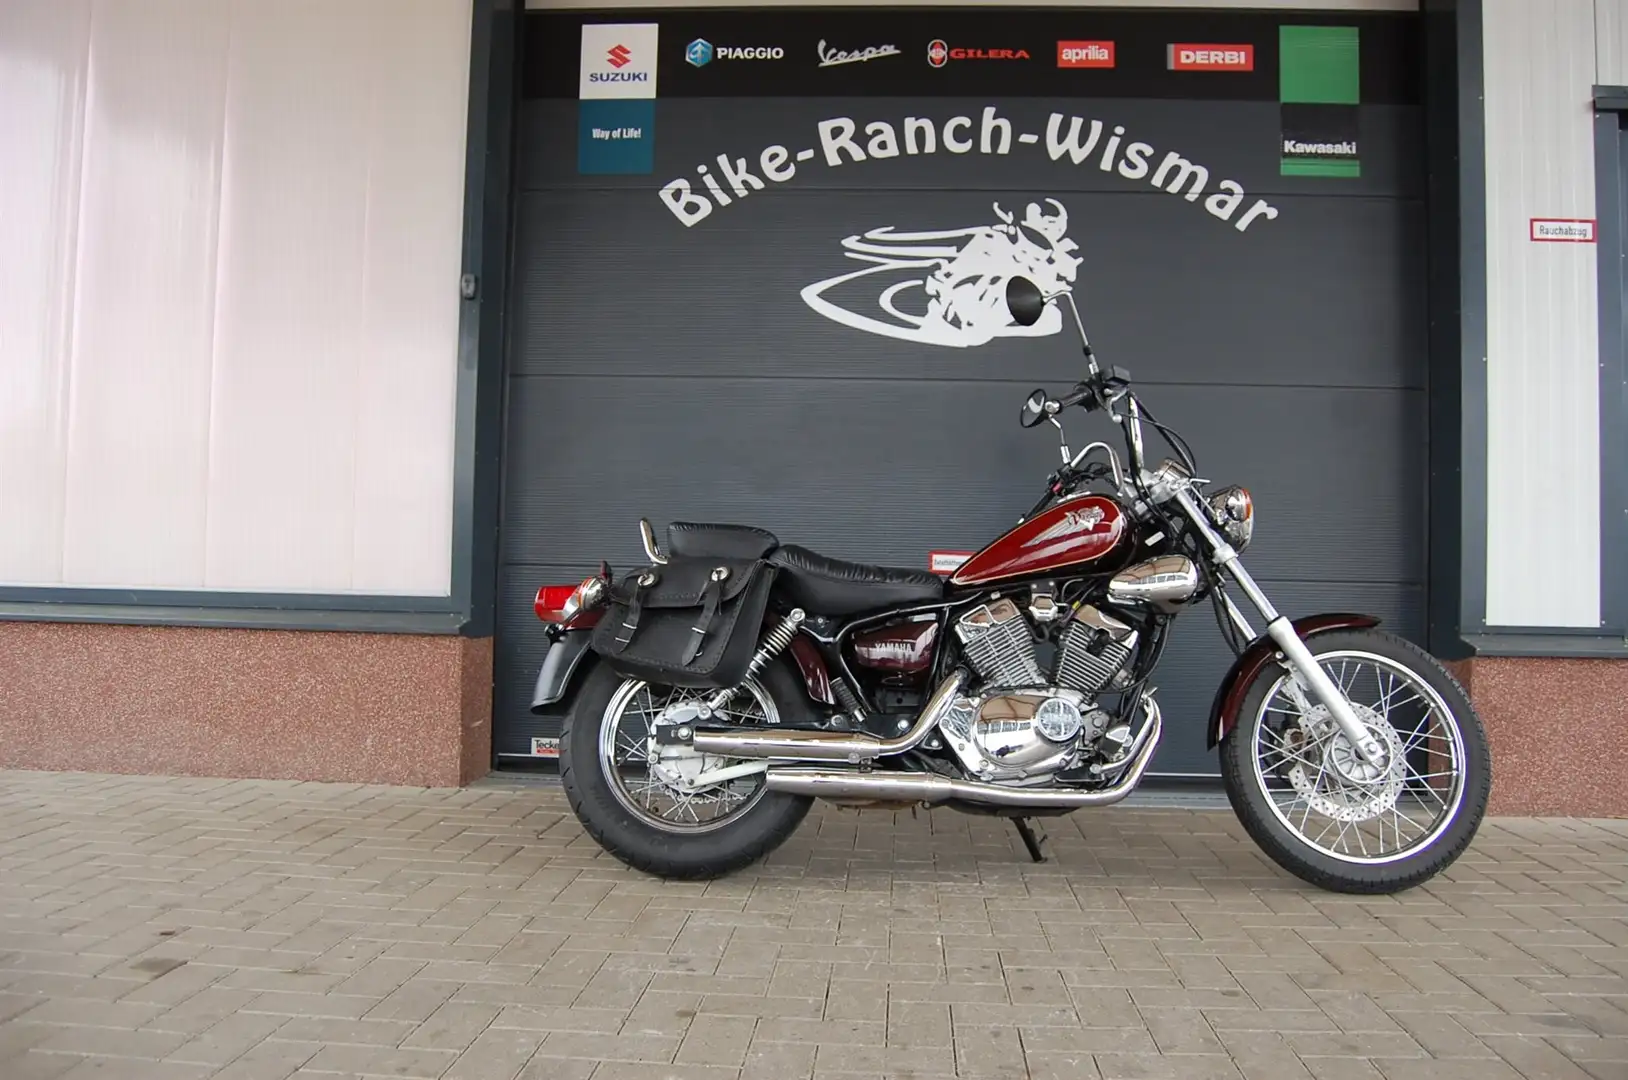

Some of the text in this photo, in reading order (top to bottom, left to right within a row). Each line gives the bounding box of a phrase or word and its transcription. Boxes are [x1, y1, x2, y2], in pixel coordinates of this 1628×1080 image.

[716, 47, 784, 60] PIAGGIO
[817, 39, 901, 68] Vespa
[949, 48, 1030, 60] GILERA
[1061, 45, 1109, 62] aprilia
[1179, 50, 1246, 65] DERBI
[589, 72, 648, 82] SUZUKI
[592, 127, 641, 140] Way of Life!
[1284, 139, 1357, 155] Kawasaki
[658, 106, 1278, 231] Bike-Ranch-Wismar
[1539, 225, 1587, 238] Rauchabzug
[875, 642, 912, 653] YAMAHA
